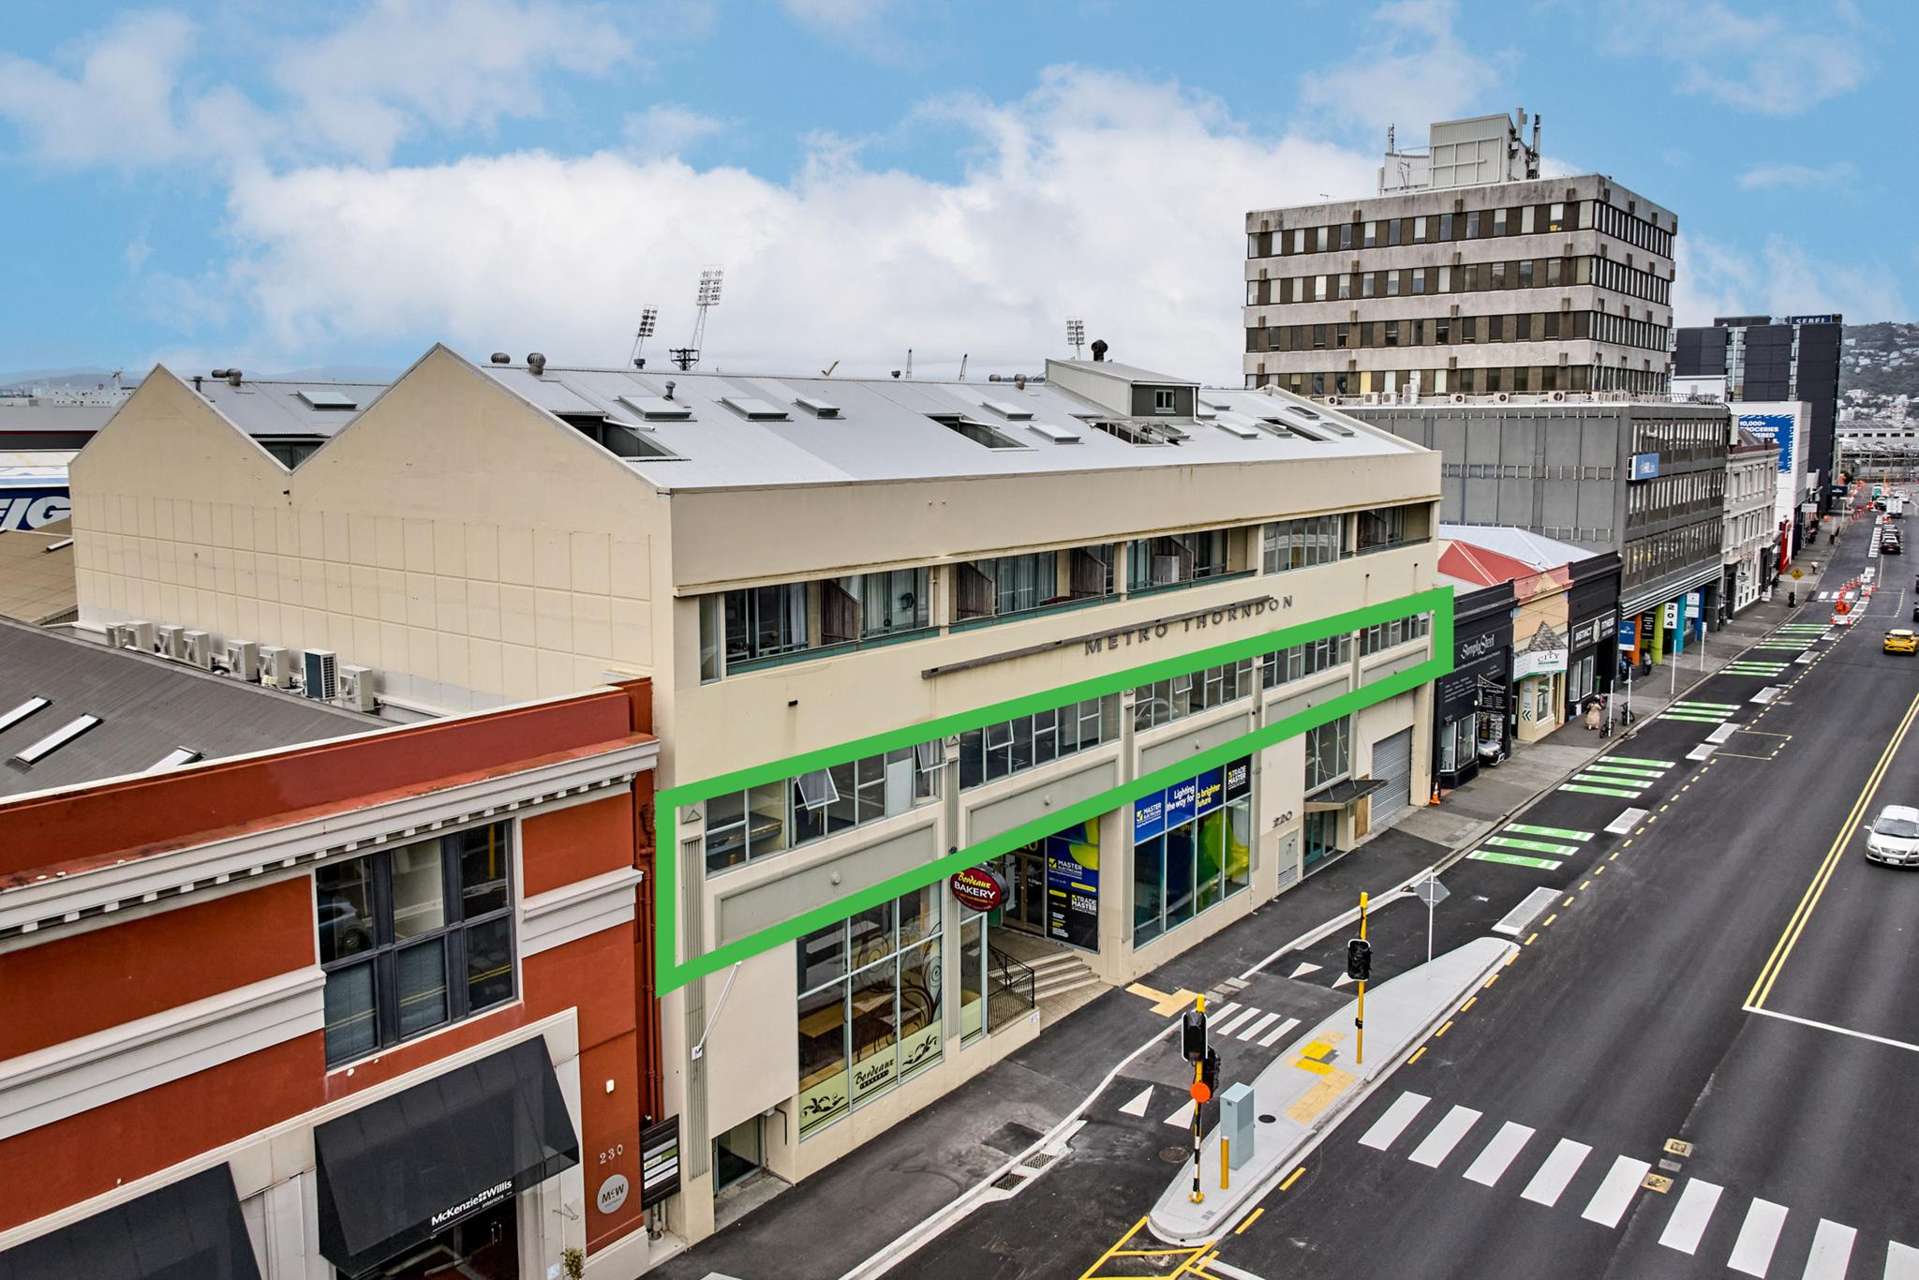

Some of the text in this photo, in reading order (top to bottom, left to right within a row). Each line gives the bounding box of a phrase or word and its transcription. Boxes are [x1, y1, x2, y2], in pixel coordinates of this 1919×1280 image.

[1085, 595, 1293, 656] METRO THORNDON
[1173, 785, 1195, 800] Lighting
[1175, 797, 1187, 808] way
[1186, 794, 1195, 803] for
[1200, 783, 1221, 798] brighter
[1143, 802, 1162, 814] MASTER
[1058, 860, 1083, 871] MASTER
[954, 881, 996, 899] BAKERY
[1071, 900, 1097, 911] MASTER
[1077, 895, 1097, 906] TRADE
[599, 1143, 624, 1165] 230
[431, 1180, 513, 1226] McKenzie Willis
